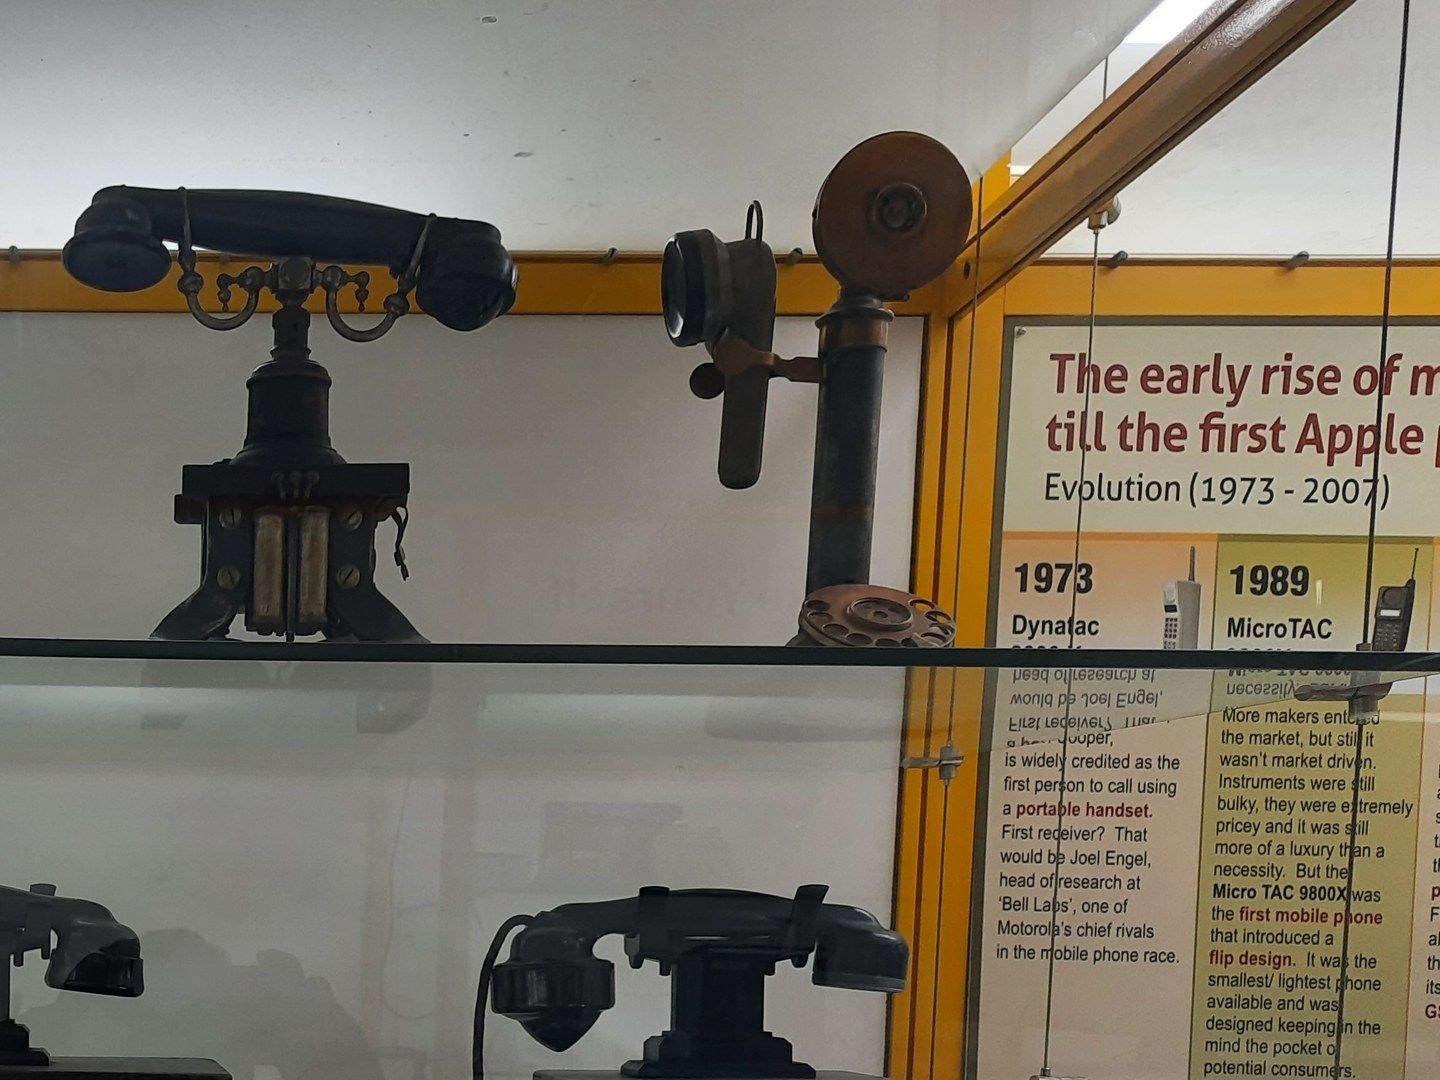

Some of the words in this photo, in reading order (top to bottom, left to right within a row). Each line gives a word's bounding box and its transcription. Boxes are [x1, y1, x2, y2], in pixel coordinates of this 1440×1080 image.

[1050, 352, 1128, 394] The
[1140, 353, 1251, 407] early
[1261, 353, 1341, 396] rise
[1353, 353, 1403, 396] of
[1046, 410, 1106, 452] till
[1118, 411, 1188, 452] the
[1200, 411, 1286, 453] first
[1295, 413, 1424, 467] Apple
[1045, 472, 1180, 502] Evolution
[1189, 471, 1275, 508] (1973
[1304, 474, 1390, 510] 2007)
[1015, 562, 1094, 593] 1973
[1229, 564, 1310, 596] 1989
[1012, 614, 1099, 639] Dynatac
[1227, 617, 1332, 639] MicroTAC
[1222, 707, 1260, 723] More
[1265, 708, 1319, 724] makers
[1221, 729, 1244, 744] the
[1249, 730, 1303, 748] market,
[1310, 731, 1332, 746] but
[1366, 733, 1374, 747] it
[1005, 753, 1016, 766] is
[1022, 753, 1066, 771] widely
[1072, 754, 1130, 769] credited
[1135, 757, 1152, 769] as
[1157, 755, 1180, 770] the
[1220, 752, 1267, 767] wasn't
[1272, 753, 1322, 768] market
[1004, 776, 1030, 792] first
[1035, 779, 1084, 794] person
[1090, 779, 1103, 792] to
[1108, 778, 1132, 793] call
[1138, 779, 1177, 797] using
[1219, 774, 1305, 790] Instruments
[1310, 777, 1346, 790] were
[1003, 804, 1011, 815] a
[1016, 802, 1080, 819] portable
[1086, 802, 1152, 818] handset.
[1217, 795, 1259, 814] bulky,
[1264, 796, 1296, 815] they
[1301, 800, 1336, 813] were
[1002, 824, 1033, 840] First
[1038, 826, 1105, 841] receiver?
[1115, 827, 1147, 842] That
[1216, 818, 1260, 836] pricey
[1265, 820, 1293, 834] and
[1298, 819, 1306, 834] it
[1311, 822, 1339, 835] was
[1000, 849, 1042, 864] would
[1048, 850, 1065, 865] be
[1070, 850, 1100, 865] Joel
[1106, 851, 1151, 869] Engel,
[1215, 842, 1253, 855] more
[1258, 841, 1273, 855] of
[1276, 844, 1285, 856] a
[1290, 841, 1334, 860] luxury
[1376, 846, 1385, 858] a
[999, 872, 1035, 888] head
[1040, 873, 1055, 888] of
[1058, 874, 1122, 890] research
[1127, 876, 1140, 890] at
[1214, 862, 1286, 881] necessity.
[1296, 863, 1320, 879] But
[1325, 864, 1348, 880] the
[1213, 883, 1256, 900] Micro
[1262, 884, 1294, 900] TAC
[1299, 885, 1348, 901] 9800X
[1352, 889, 1381, 902] was
[1081, 901, 1108, 913] one
[1114, 899, 1128, 913] of
[1211, 906, 1234, 921] the
[1240, 906, 1270, 922] first
[1275, 908, 1328, 924] mobile
[998, 920, 1072, 937] Motorola's
[1077, 923, 1112, 937] chief
[1116, 924, 1154, 938] rivals
[1210, 928, 1238, 943] that
[1242, 929, 1320, 945] introduced
[1325, 933, 1334, 945] a
[997, 944, 1008, 958] in
[1013, 944, 1035, 959] the
[1041, 945, 1088, 961] mobile
[1093, 946, 1138, 965] phone
[1143, 951, 1180, 963] race.
[1209, 950, 1234, 968] flip
[1239, 951, 1296, 970] design.
[1307, 953, 1315, 967] It
[1355, 953, 1377, 969] the
[1208, 972, 1275, 988] smallest/
[1278, 973, 1331, 992] lightest
[1207, 994, 1272, 1010] available
[1277, 996, 1305, 1011] and
[1309, 999, 1339, 1011] was
[1206, 1015, 1273, 1034] designed
[1278, 1018, 1335, 1037] keeping
[1359, 1020, 1381, 1035] the
[1205, 1038, 1241, 1053] mind
[1245, 1038, 1268, 1054] the
[1273, 1040, 1322, 1057] pocket
[1204, 1060, 1266, 1077] potential
[1271, 1061, 1355, 1078] consumers.
